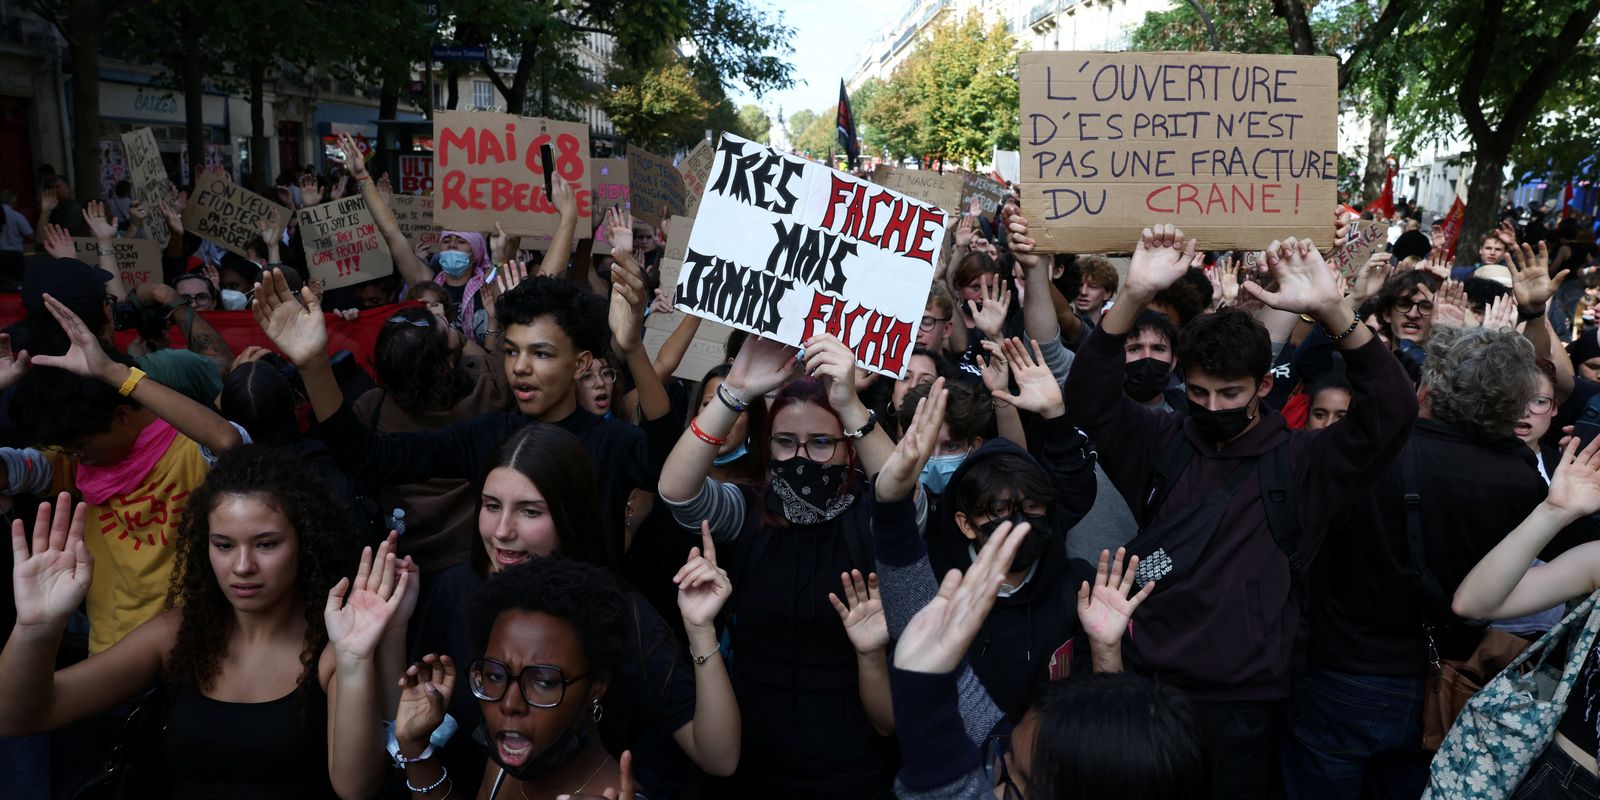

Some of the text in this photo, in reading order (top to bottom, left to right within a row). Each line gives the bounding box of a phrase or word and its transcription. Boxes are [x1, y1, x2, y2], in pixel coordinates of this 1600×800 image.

[424, 4, 438, 16] US
[1047, 61, 1297, 103] L'OUVERTURE
[1216, 112, 1304, 140] N'EST
[402, 157, 434, 177] ULT
[438, 123, 517, 167] MAI
[525, 133, 585, 182] 68
[1033, 146, 1337, 181] PAS UNE FRACTURE
[210, 180, 236, 198] ON
[402, 177, 434, 192] BO
[198, 190, 260, 229] ETUDIER
[300, 197, 366, 226] ALL I WANT
[420, 198, 434, 209] JE
[709, 136, 945, 267] TRÈS FACHÉ
[1042, 189, 1107, 220] DU
[315, 212, 360, 236] TO SAY IS
[312, 235, 379, 266] CARE ABOUT US
[765, 217, 859, 296] MAIS
[674, 247, 795, 336] JAMAIS
[798, 288, 916, 375] FACHO
